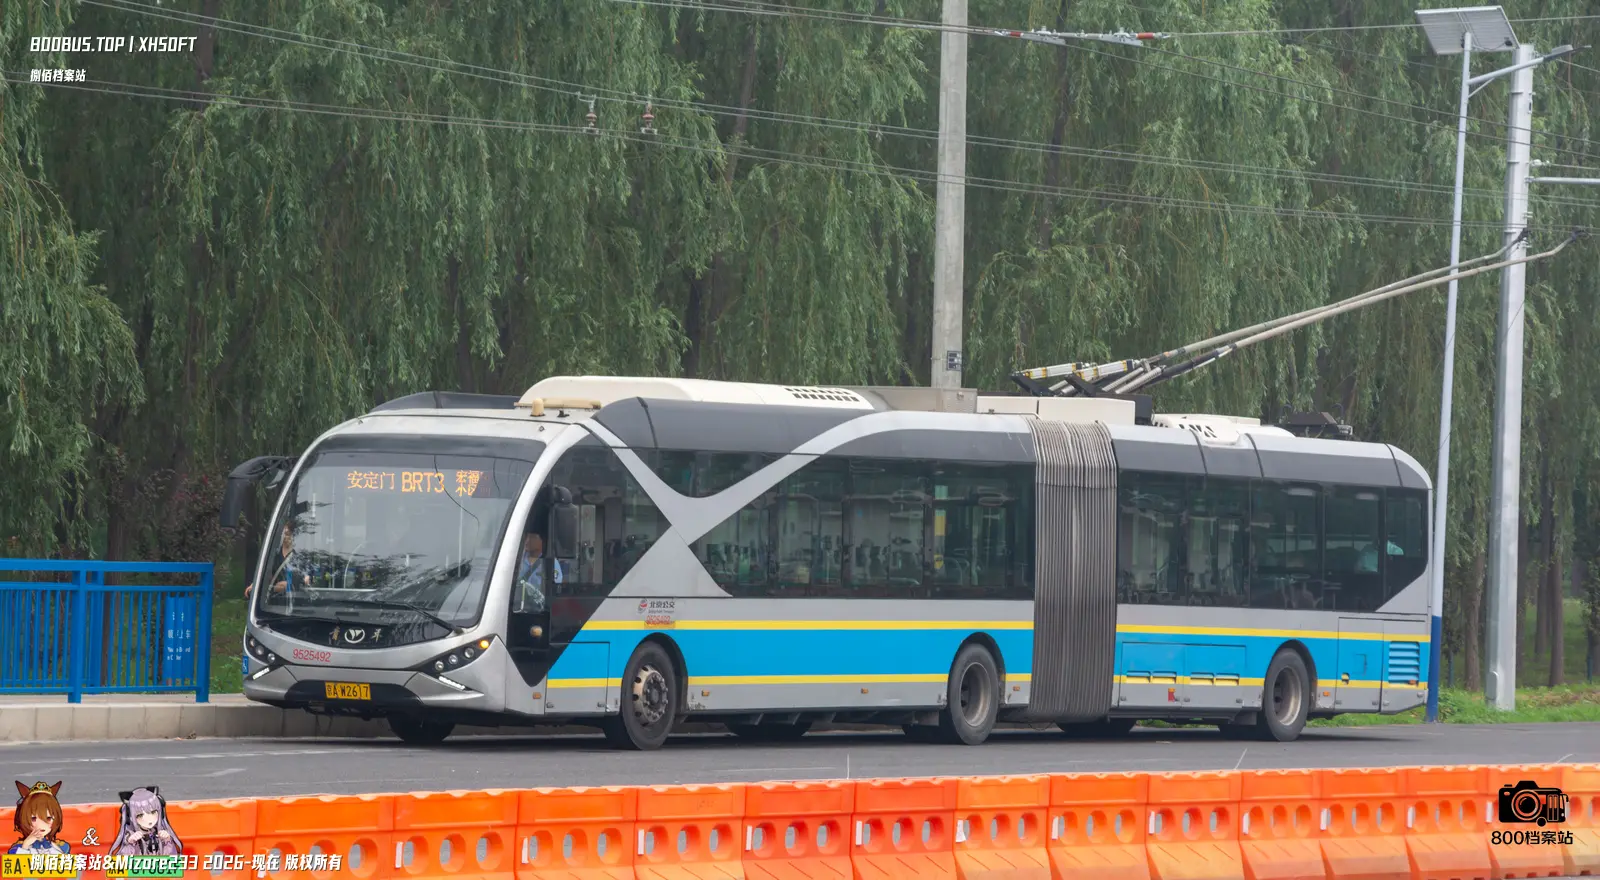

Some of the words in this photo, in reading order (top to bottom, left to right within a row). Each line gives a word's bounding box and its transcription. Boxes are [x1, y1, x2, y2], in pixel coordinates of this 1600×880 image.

[347, 470, 395, 490] 安定门
[401, 471, 445, 493] BRT3
[293, 648, 331, 662] 9525492
